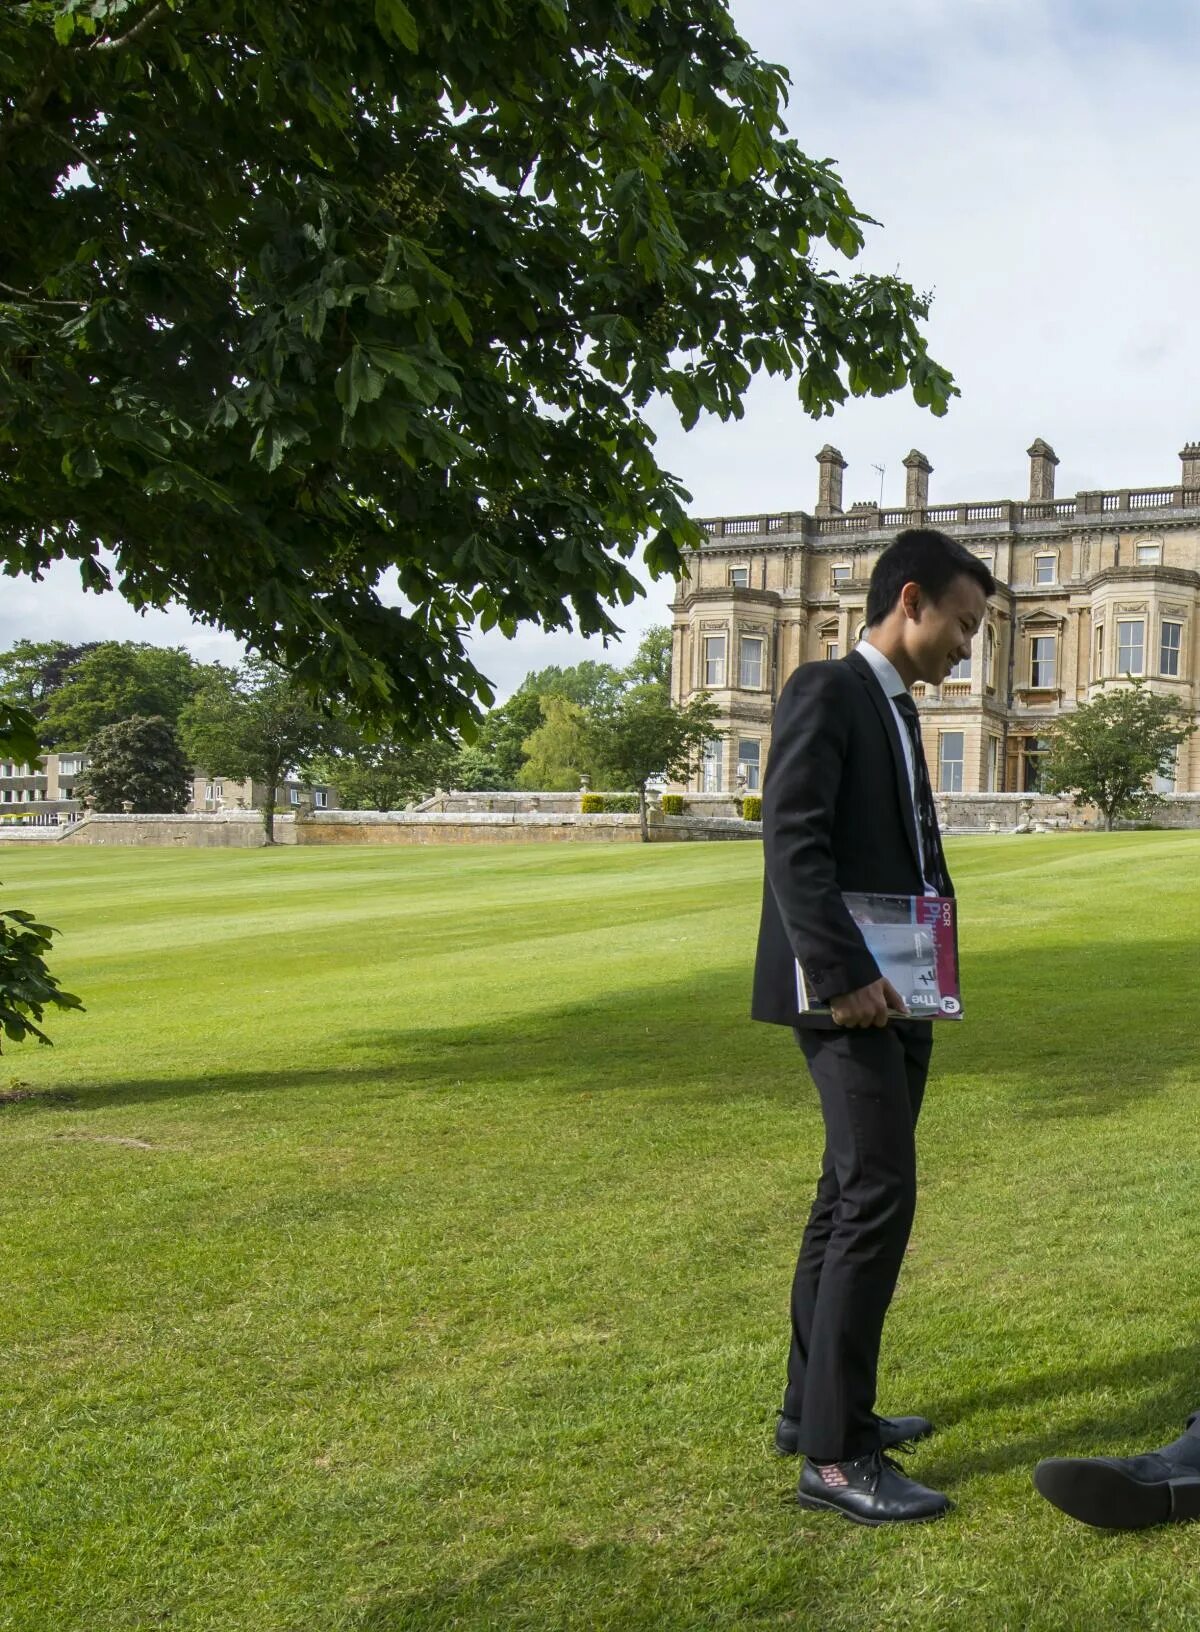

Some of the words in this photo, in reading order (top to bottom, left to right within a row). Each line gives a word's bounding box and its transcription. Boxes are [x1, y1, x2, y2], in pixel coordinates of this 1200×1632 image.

[943, 903, 951, 927] OCR
[911, 995, 937, 1006] The
[944, 1000, 954, 1010] A2
